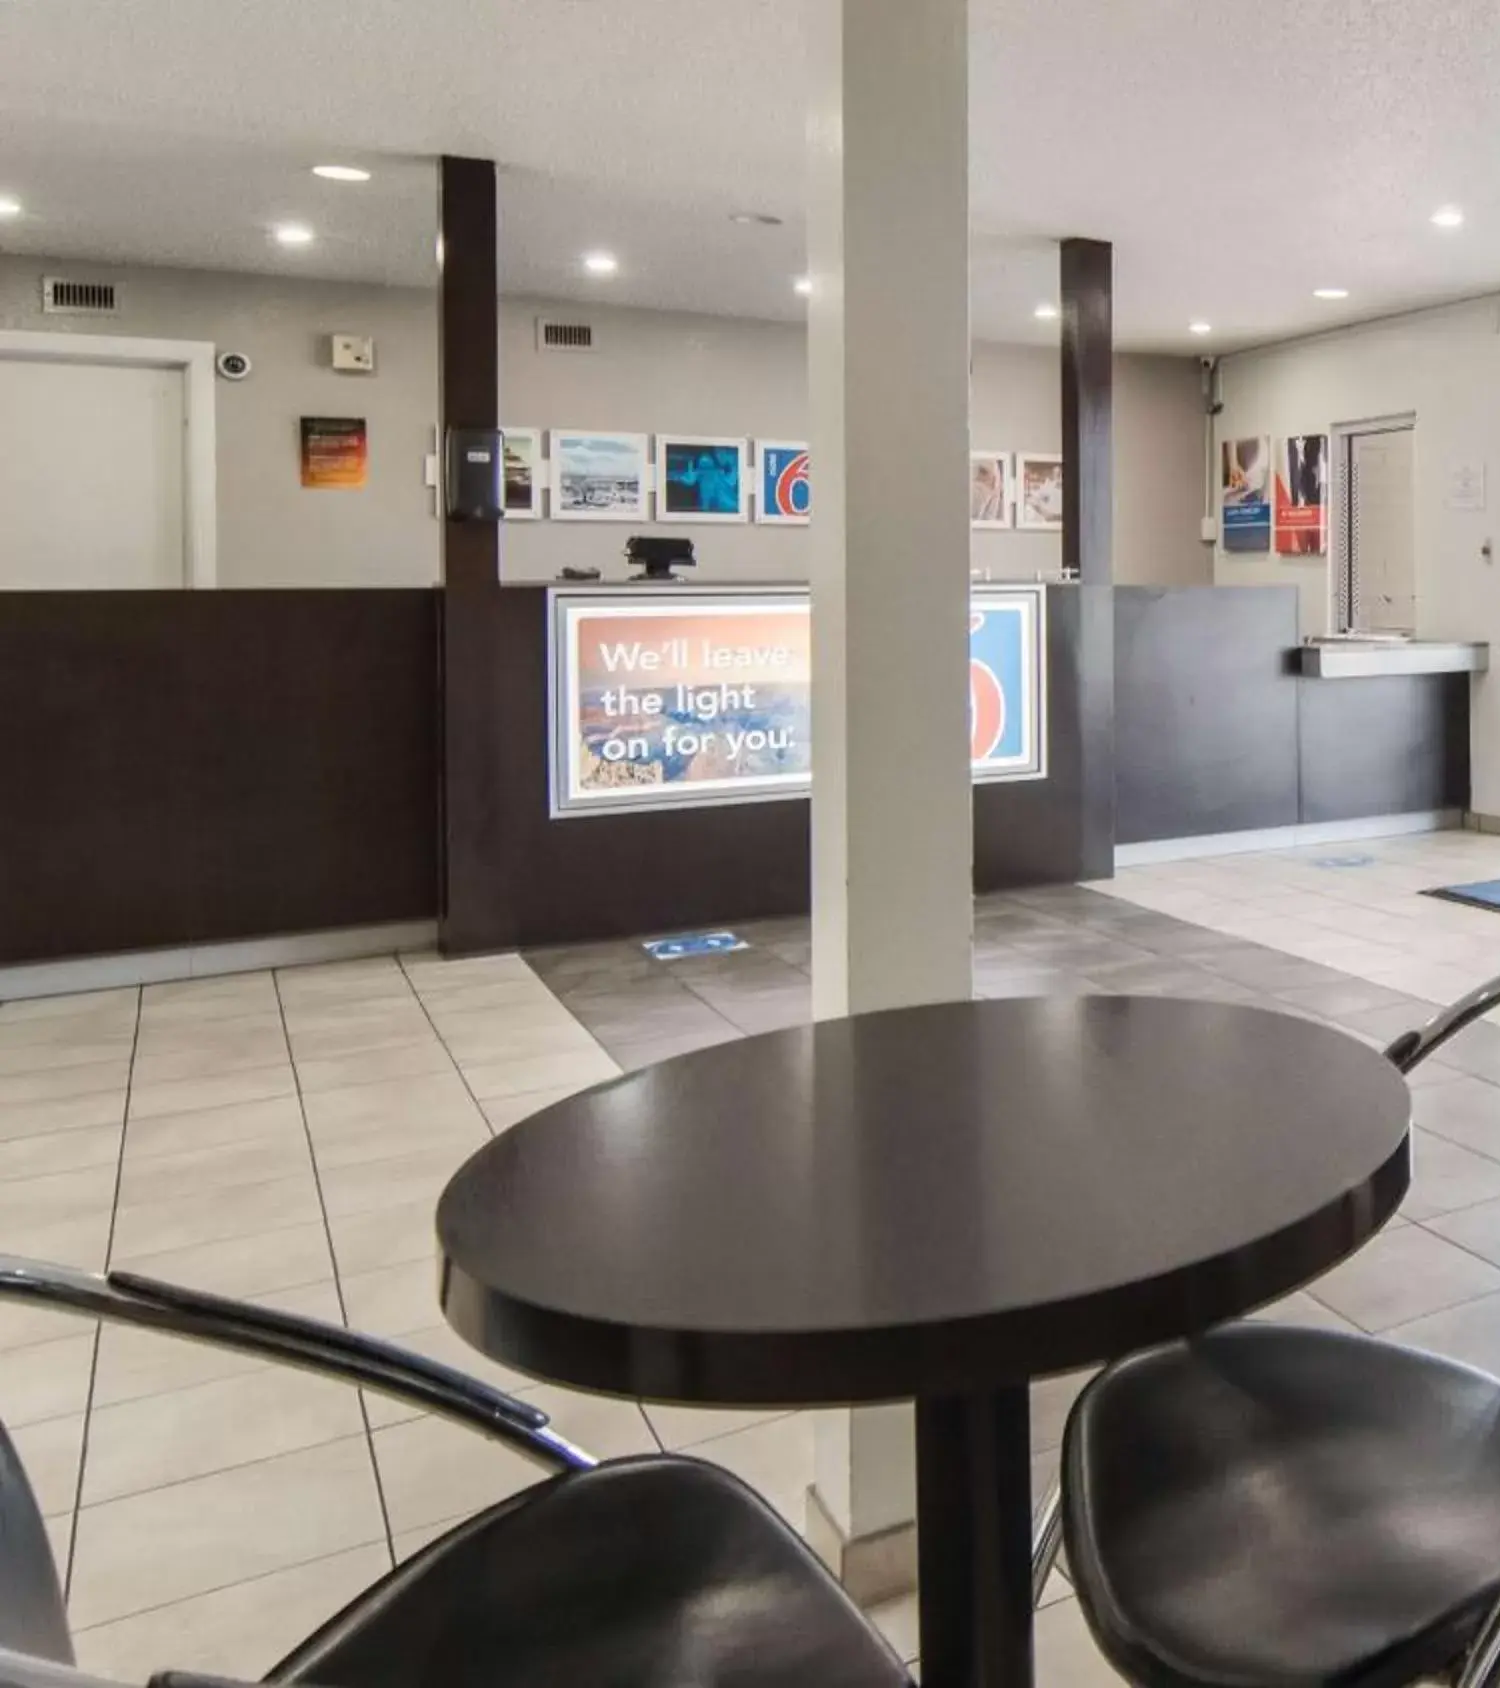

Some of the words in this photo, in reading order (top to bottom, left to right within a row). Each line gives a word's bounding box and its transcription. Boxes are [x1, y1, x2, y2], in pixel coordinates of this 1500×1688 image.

[600, 637, 690, 673] We'll
[703, 640, 790, 669] leave
[600, 683, 664, 716] the
[676, 681, 757, 719] light
[602, 737, 650, 761] on
[661, 724, 715, 757] for
